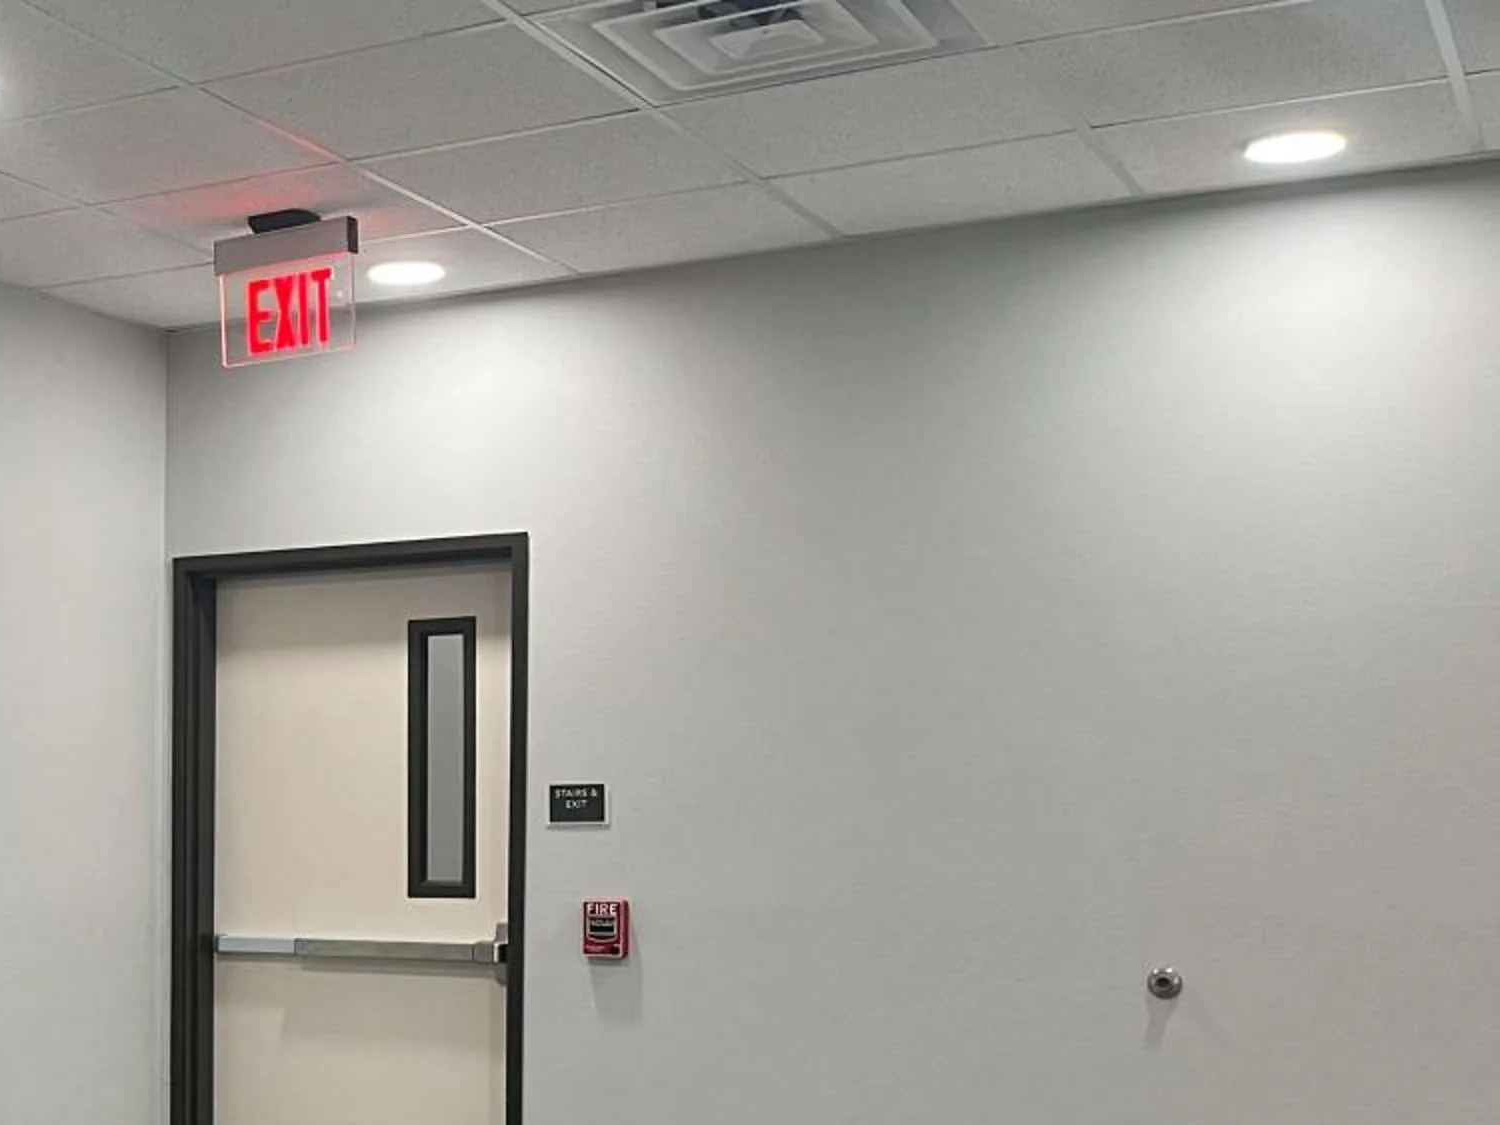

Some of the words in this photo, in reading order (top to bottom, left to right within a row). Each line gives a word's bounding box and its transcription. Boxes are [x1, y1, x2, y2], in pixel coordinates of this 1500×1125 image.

[247, 267, 333, 354] EXIT
[554, 787, 587, 799] STAIRS
[590, 787, 598, 797] &
[565, 799, 587, 809] EXIT
[587, 903, 618, 916] FIRE
